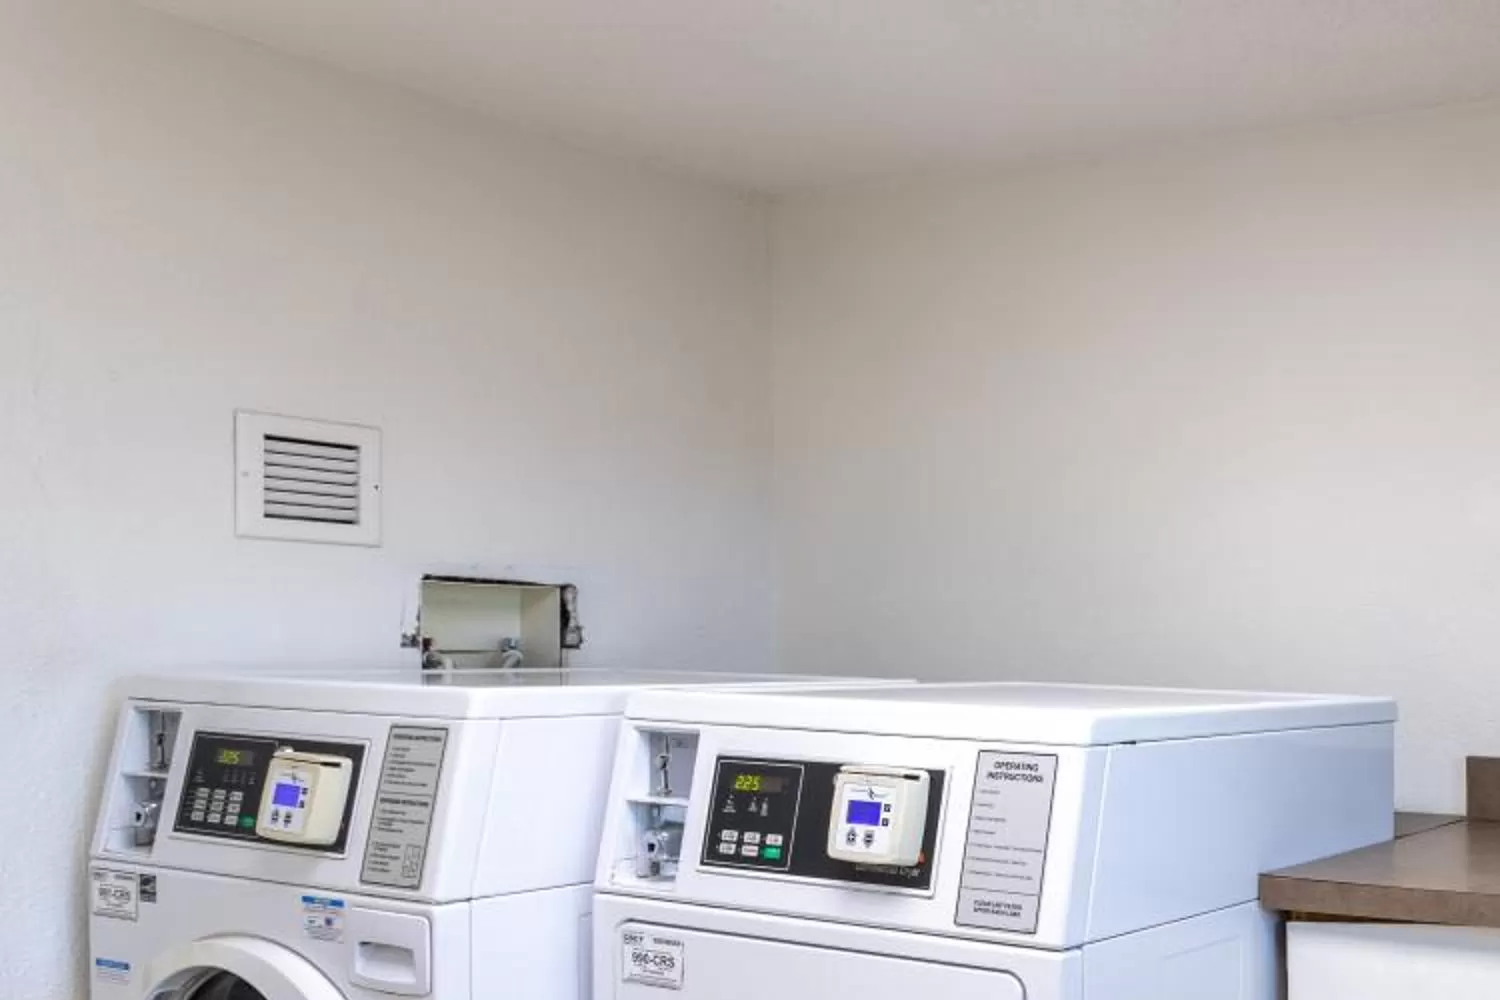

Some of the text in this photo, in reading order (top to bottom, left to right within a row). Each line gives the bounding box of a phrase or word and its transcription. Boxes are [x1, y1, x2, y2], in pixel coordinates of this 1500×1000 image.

[993, 761, 1039, 773] OPERATING
[734, 775, 760, 791] 225
[986, 771, 1044, 783] INSTRUCTIONS
